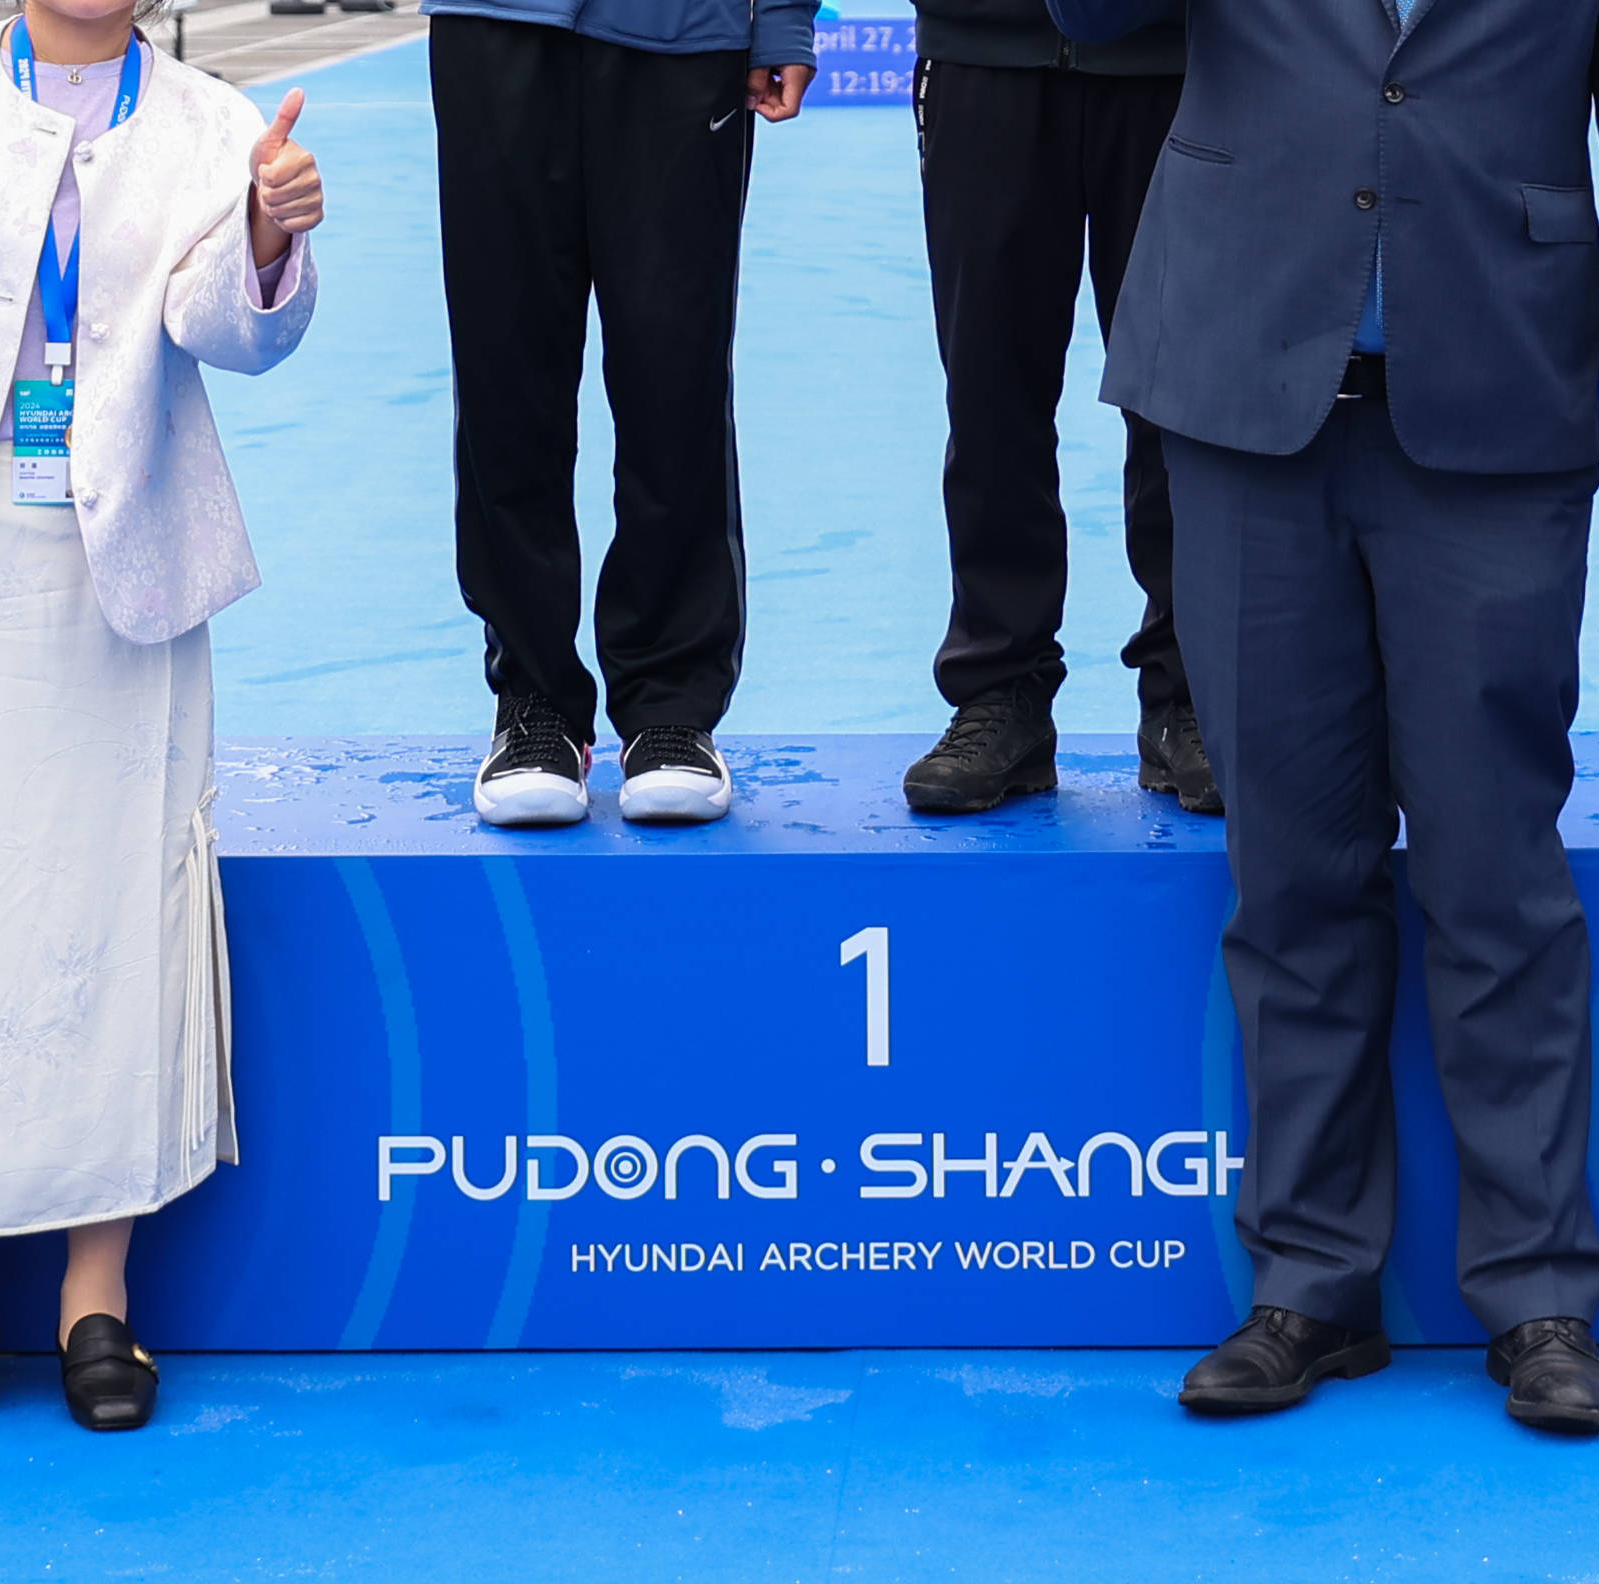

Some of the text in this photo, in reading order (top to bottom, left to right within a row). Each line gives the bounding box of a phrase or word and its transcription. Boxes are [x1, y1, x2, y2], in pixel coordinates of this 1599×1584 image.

[814, 26, 857, 54] pril
[862, 26, 904, 53] 27,
[840, 926, 889, 1066] 1
[378, 1133, 798, 1201] PUDONG
[571, 1239, 1187, 1272] HYUNDAI ARCHERY WORLD CUP
